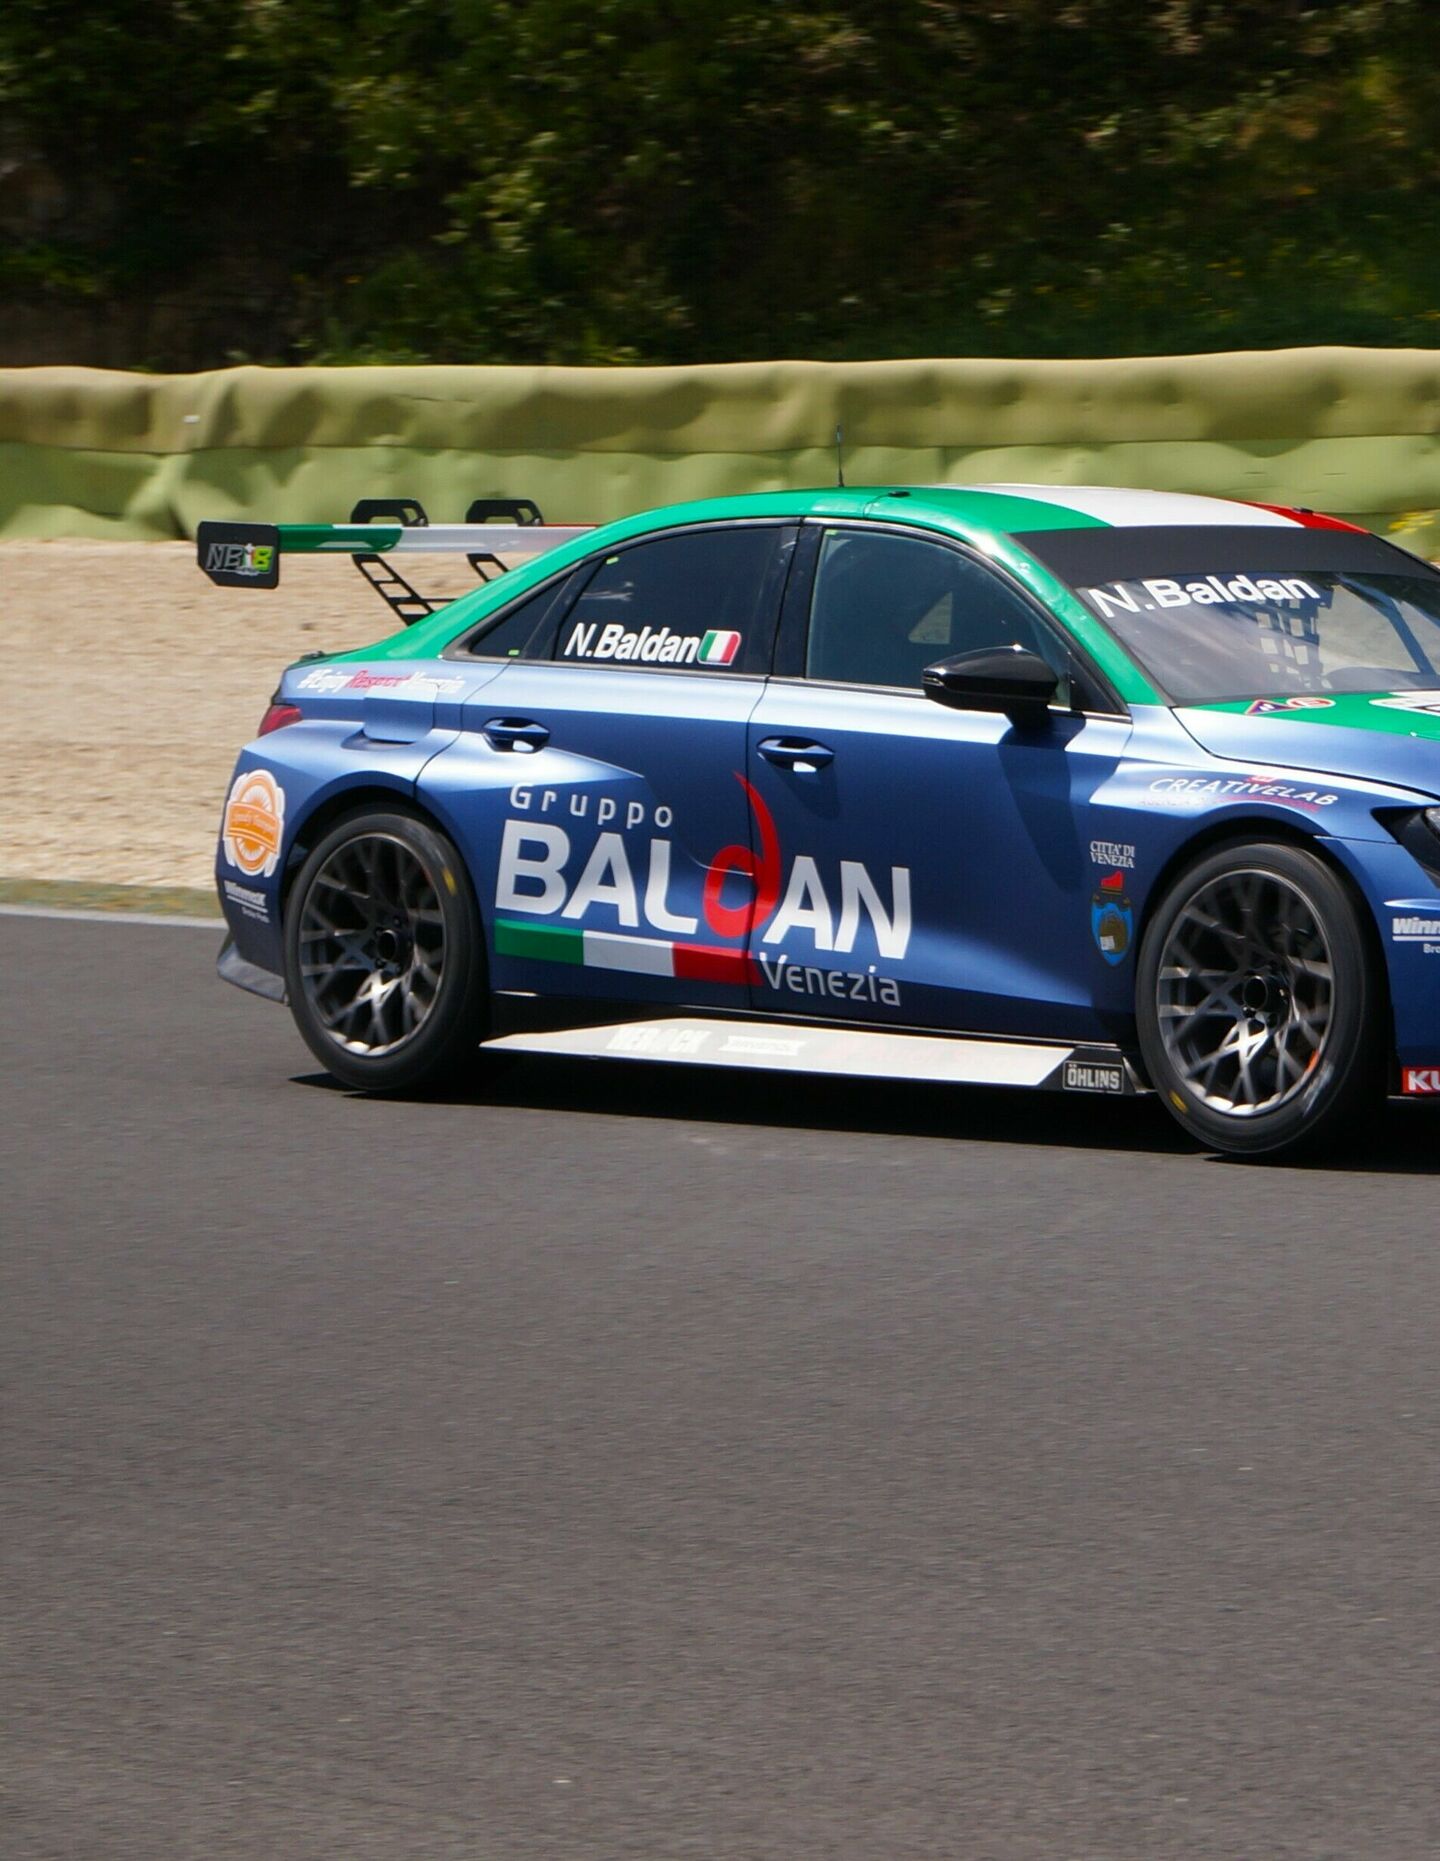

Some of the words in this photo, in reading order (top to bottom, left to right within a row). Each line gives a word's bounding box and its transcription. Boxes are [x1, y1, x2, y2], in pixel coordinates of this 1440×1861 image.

[1087, 574, 1321, 618] N.Baldan
[564, 622, 700, 663] N.Baldan
[510, 782, 673, 829] Gruppo
[1150, 777, 1339, 806] CREATIVELAB
[1090, 851, 1135, 869] VENEZIA
[1123, 845, 1135, 858] DI
[759, 952, 901, 1007] Venezia
[1067, 1063, 1120, 1090] ÖHLINS
